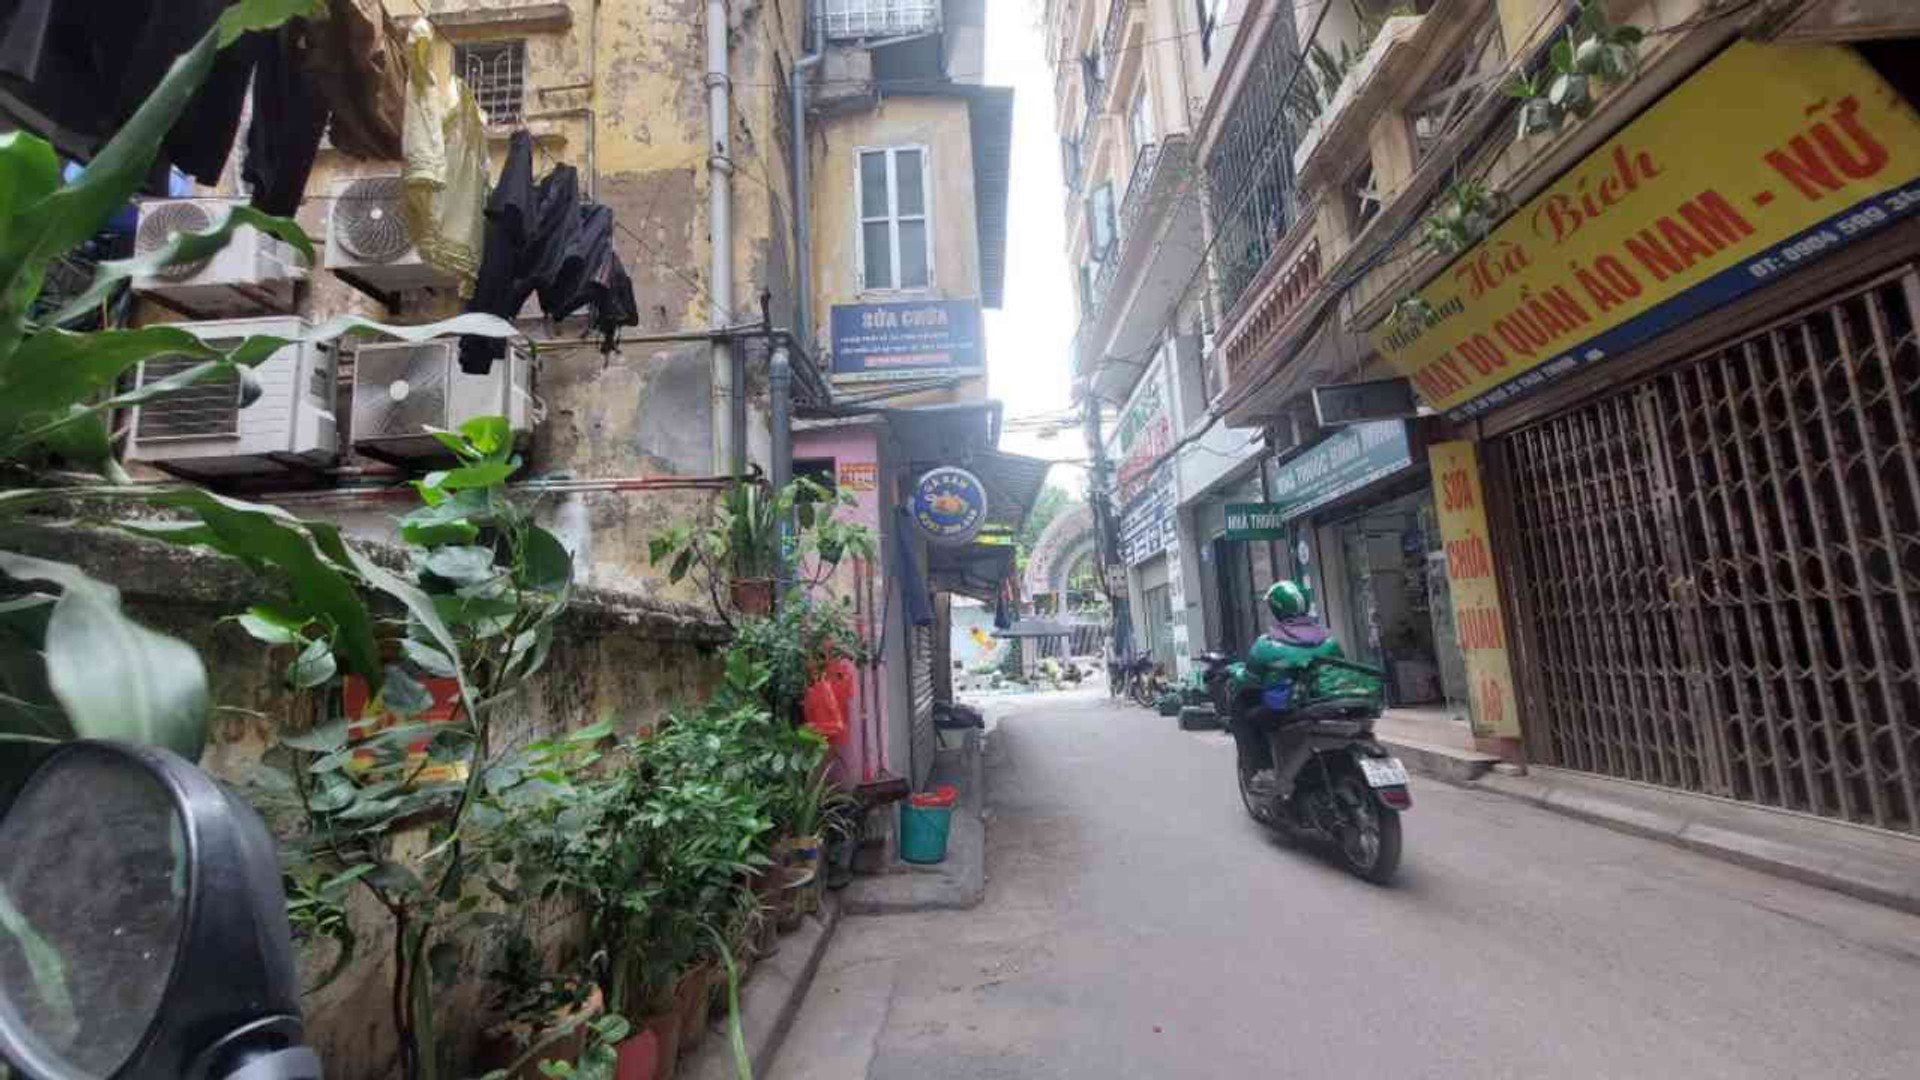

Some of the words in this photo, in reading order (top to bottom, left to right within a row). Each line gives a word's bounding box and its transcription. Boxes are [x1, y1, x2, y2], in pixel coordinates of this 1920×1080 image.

[1414, 354, 1472, 401] MAY
[1494, 284, 1593, 358] QUẦN
[1569, 260, 1642, 313] ÁO
[1623, 189, 1755, 282] NAM
[1764, 95, 1888, 201] NỮ
[1532, 143, 1665, 244] Bích
